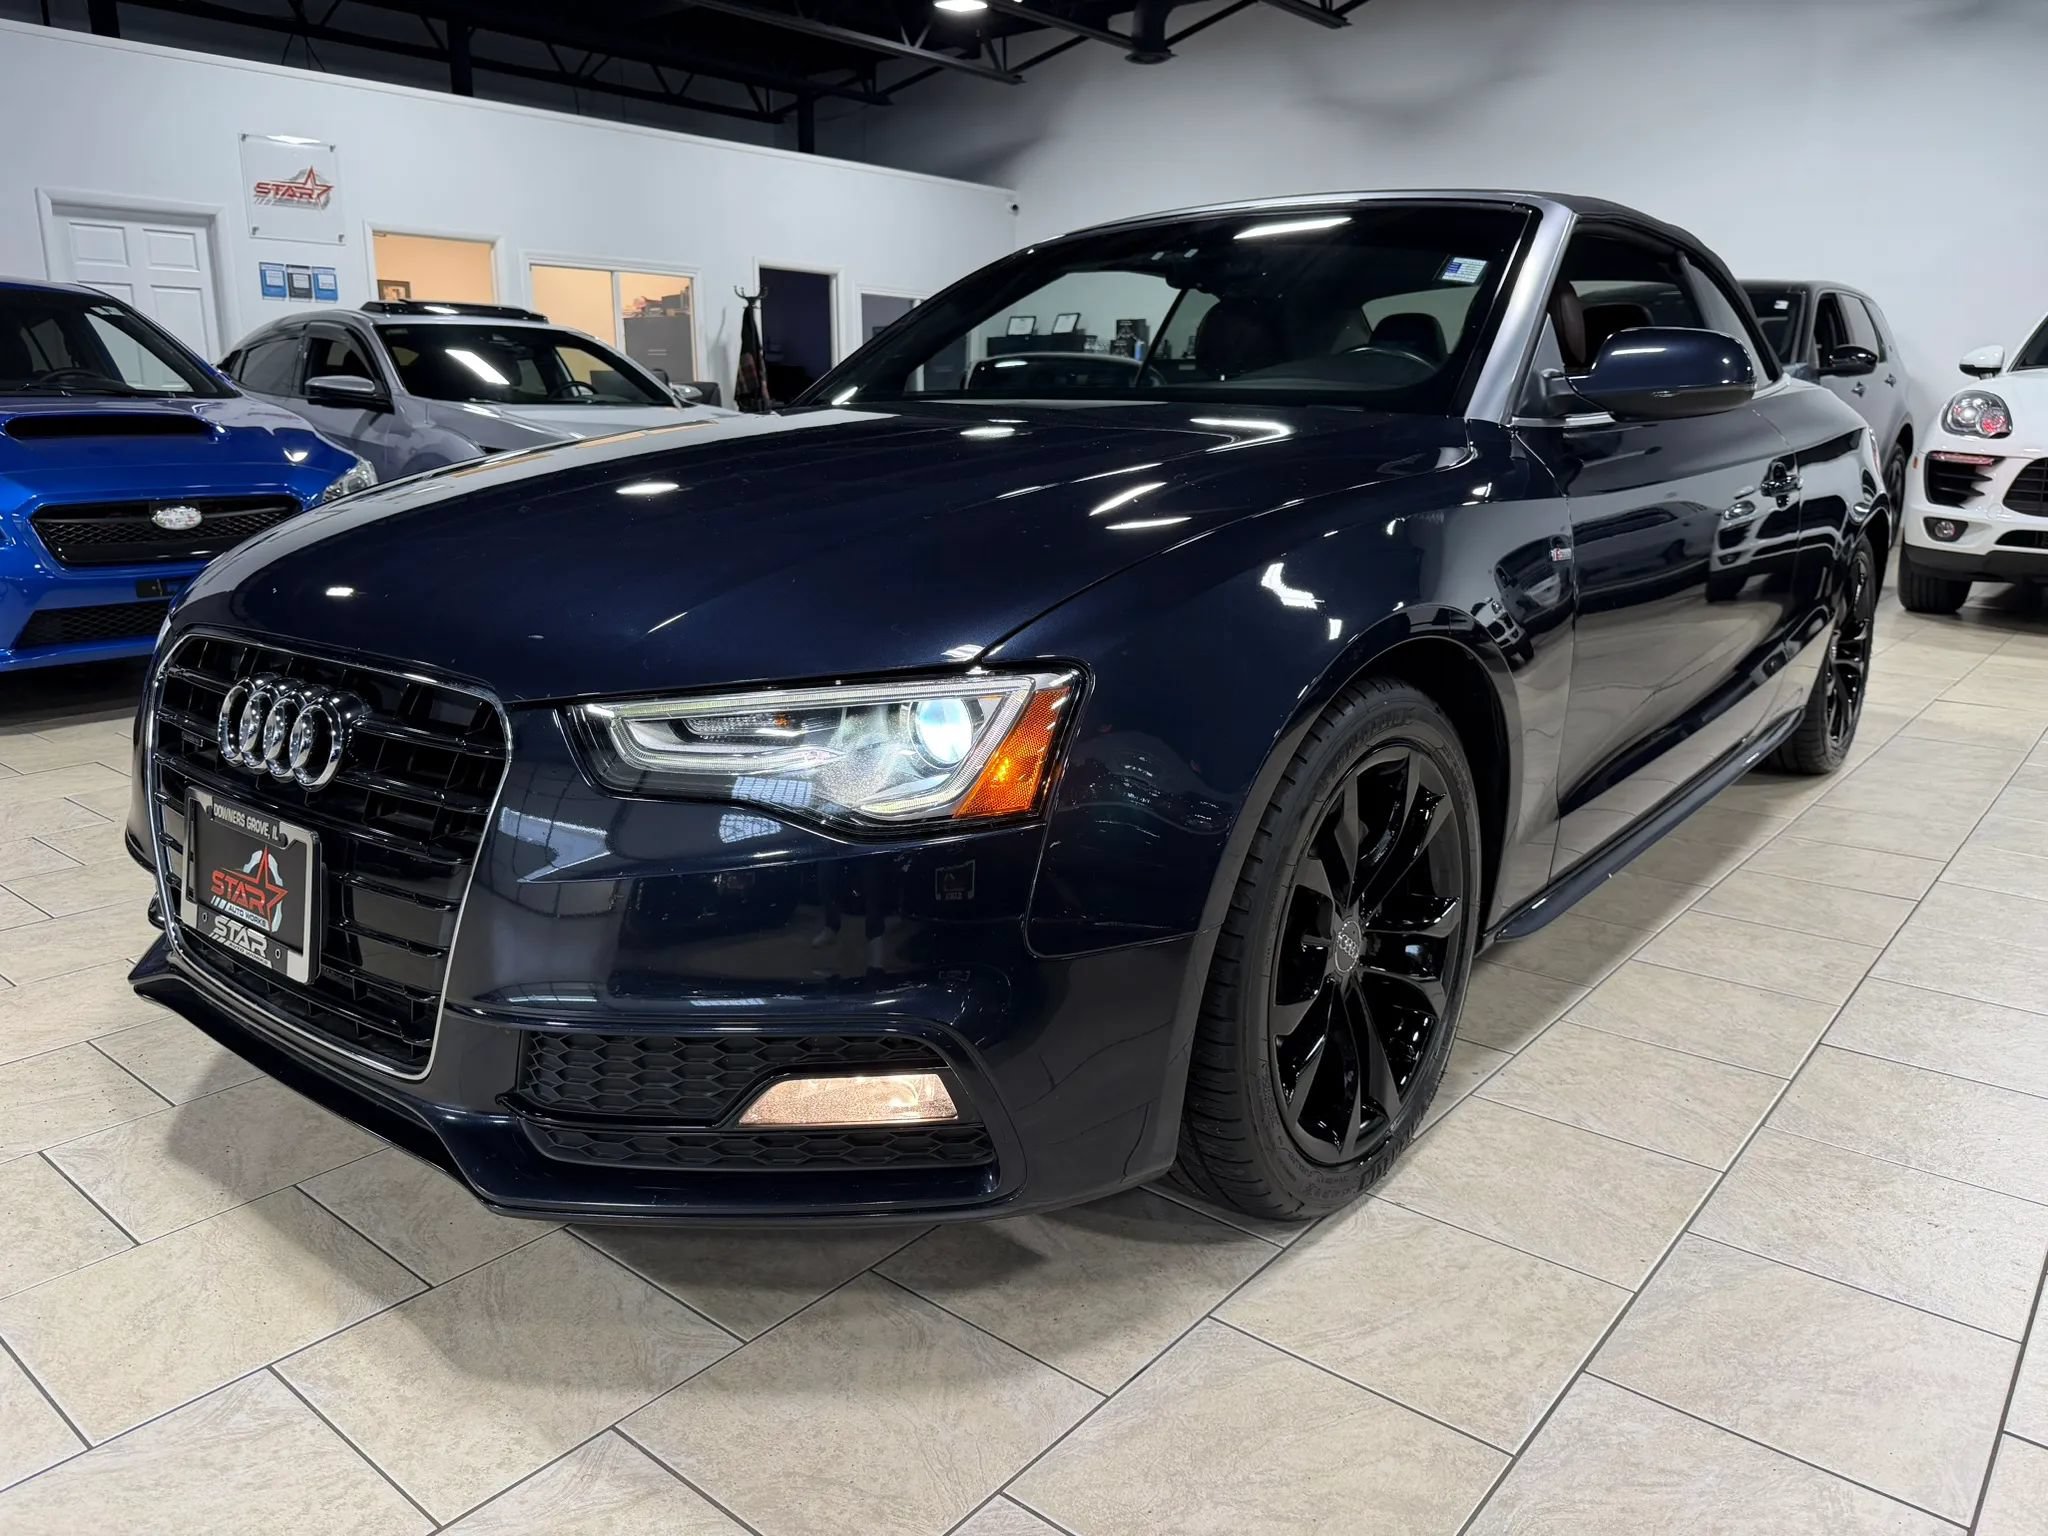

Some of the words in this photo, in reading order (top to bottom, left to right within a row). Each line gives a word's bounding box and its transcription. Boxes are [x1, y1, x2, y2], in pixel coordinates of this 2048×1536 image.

[255, 182, 314, 200] STAR
[213, 803, 245, 827] DOWNERS
[246, 816, 270, 840] GROVE,
[271, 825, 279, 841] IL
[210, 869, 265, 918] STAR
[229, 904, 244, 917] AUTO
[245, 911, 266, 928] WORKS
[212, 915, 267, 958] STAR
